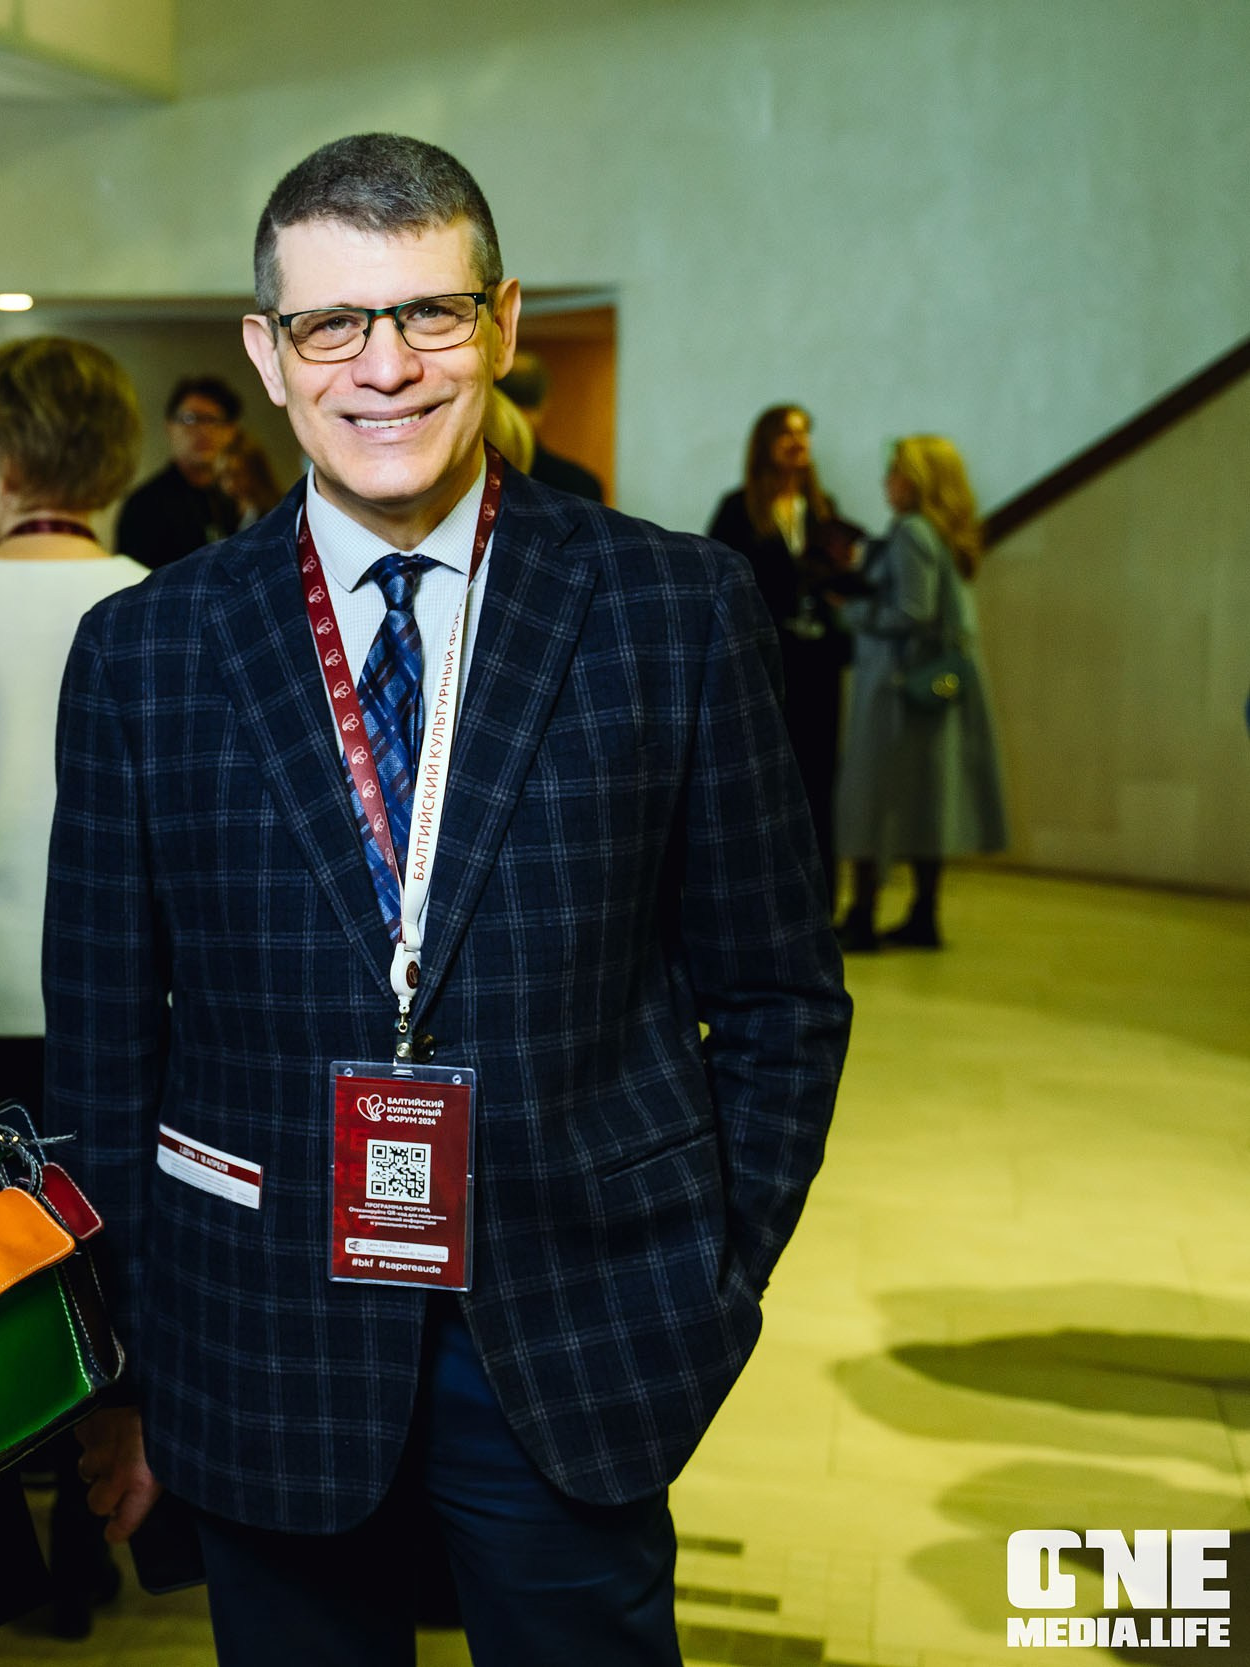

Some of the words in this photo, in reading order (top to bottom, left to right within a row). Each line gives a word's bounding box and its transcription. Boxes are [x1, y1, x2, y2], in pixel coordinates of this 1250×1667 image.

[413, 764, 440, 881] БАЛТИЙСКИЙ
[429, 650, 455, 759] КУЛЬТУРНЫЙ
[386, 1096, 444, 1109] БАЛТИЙСКИЙ
[386, 1106, 442, 1118] КУЛЬТУРНЫЙ
[386, 1114, 417, 1124] ФОРУМ
[418, 1117, 437, 1126] 2024
[351, 1257, 374, 1268] #bkf
[378, 1259, 442, 1275] #sapereaude
